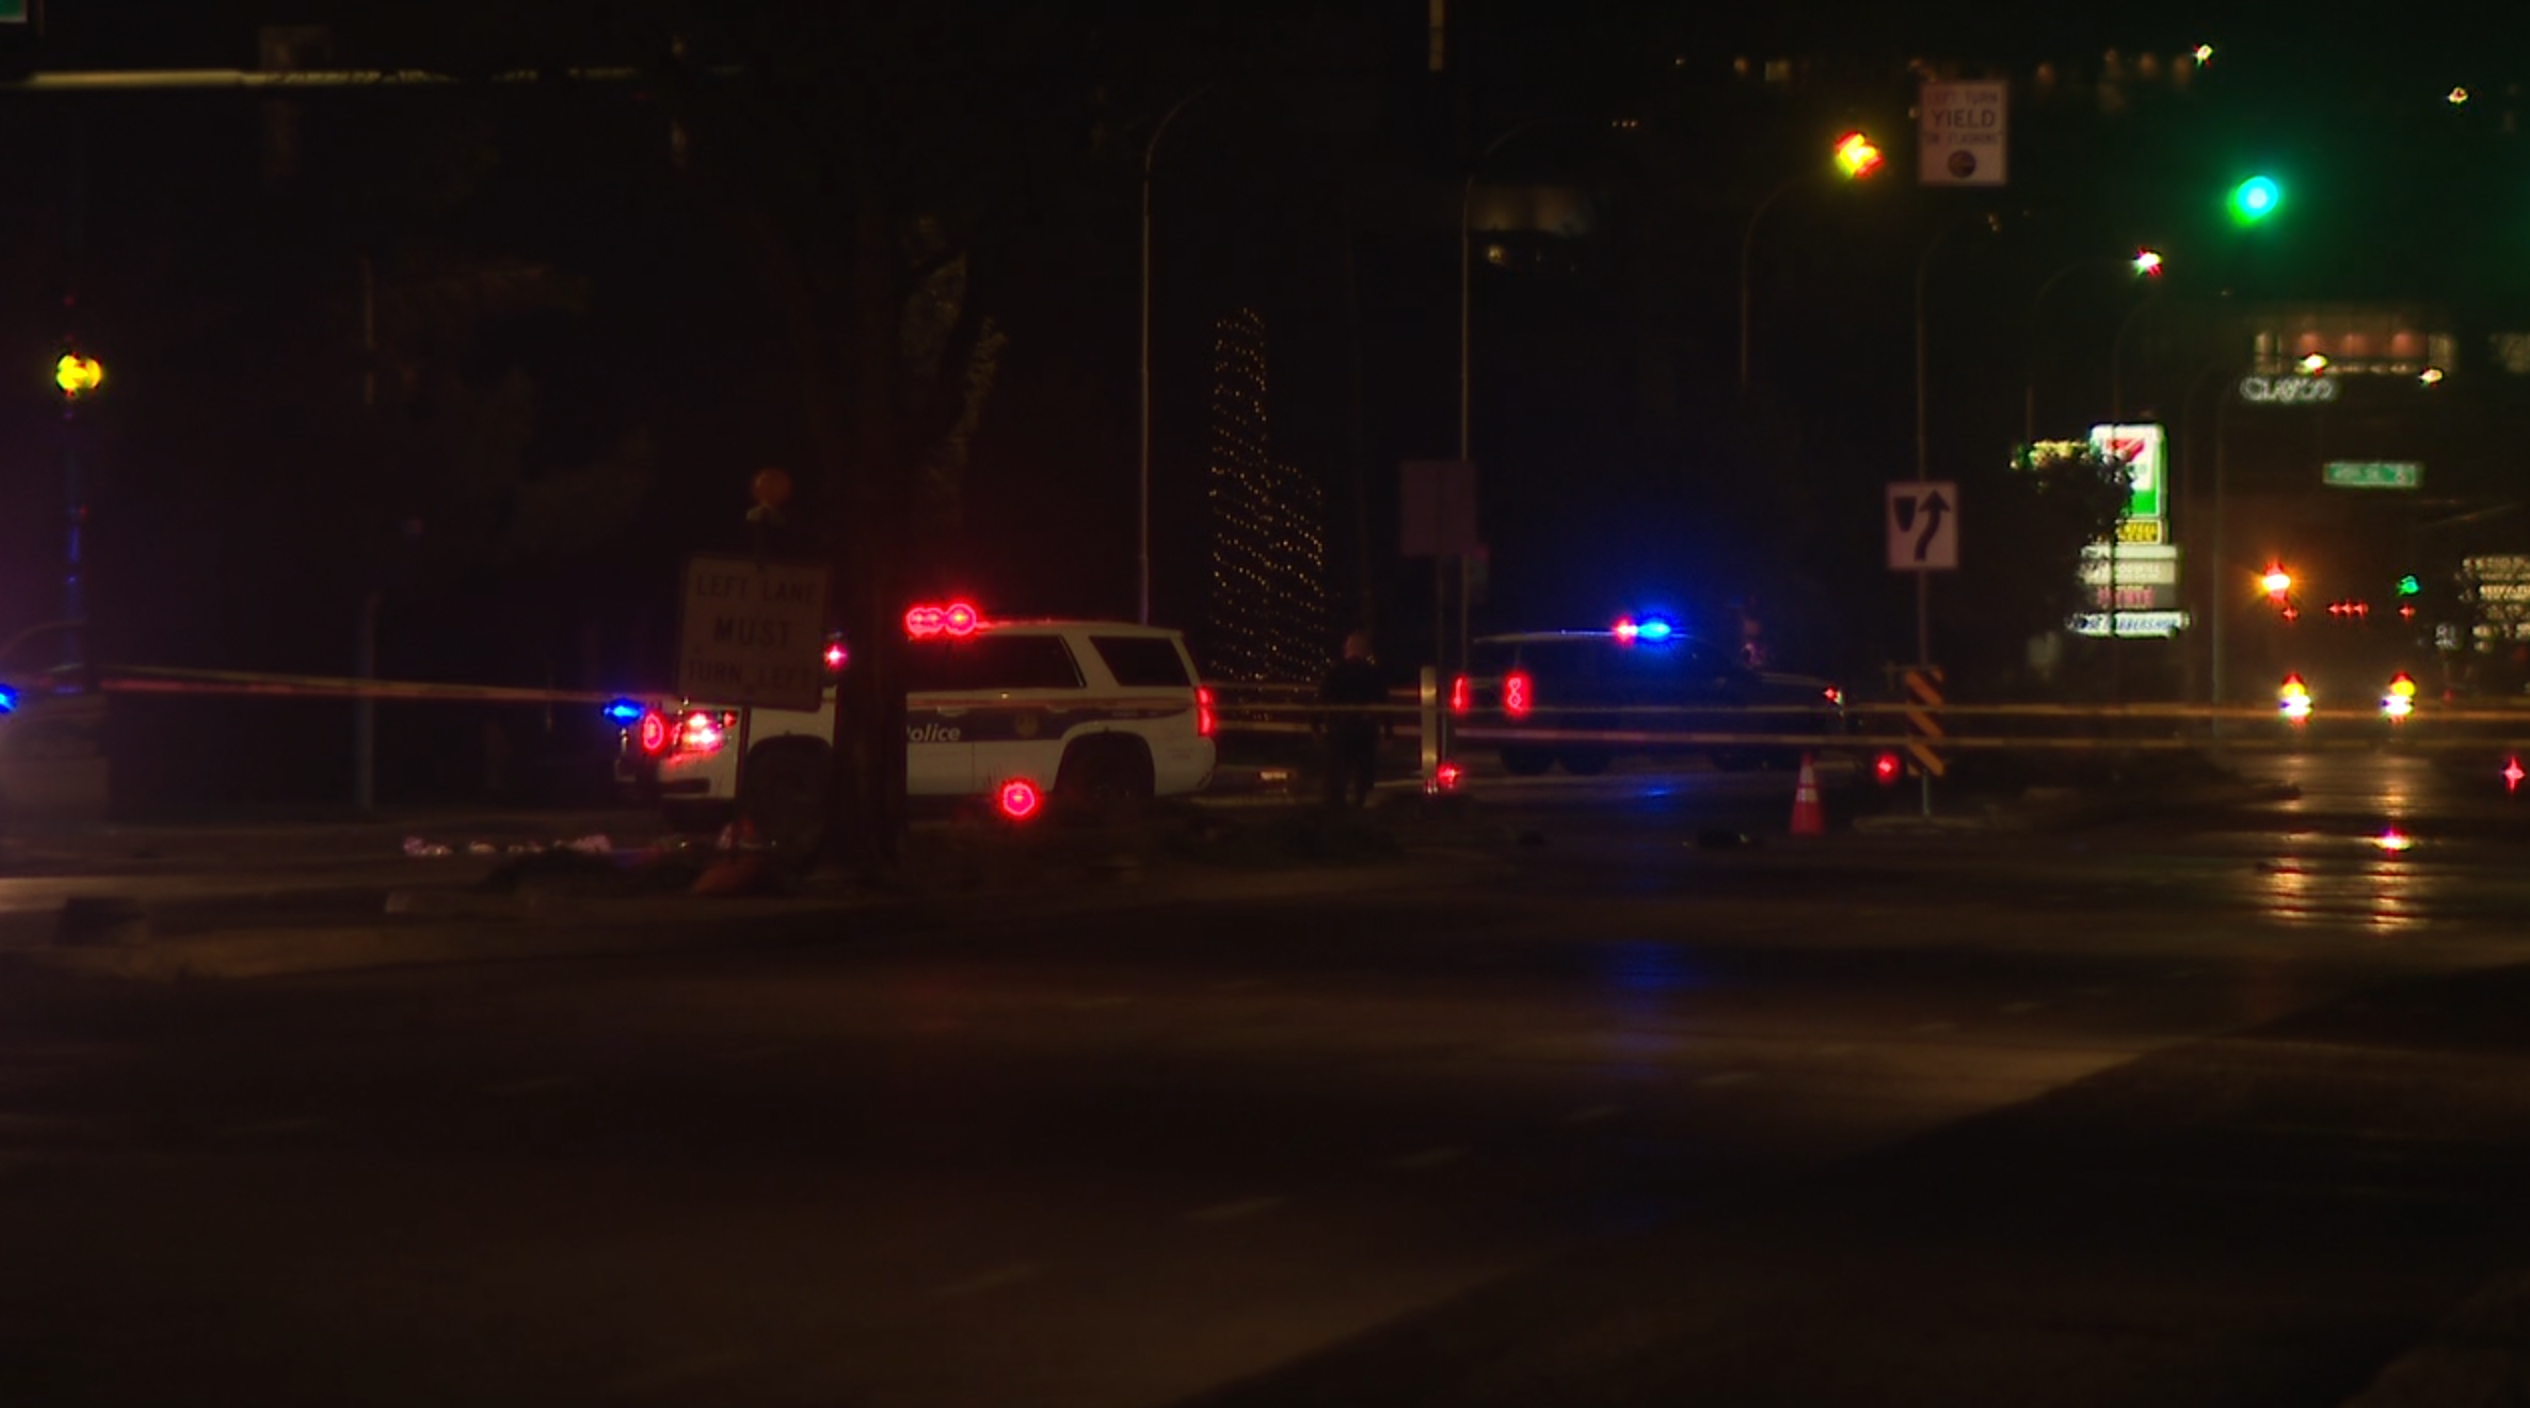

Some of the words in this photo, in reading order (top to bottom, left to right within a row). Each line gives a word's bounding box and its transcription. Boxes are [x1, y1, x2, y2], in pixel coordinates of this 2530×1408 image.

[1930, 109, 1996, 128] YIELD
[696, 574, 750, 597] LEFT
[763, 579, 817, 604] LANE
[714, 616, 791, 648] MUST
[689, 659, 742, 684] TURN
[758, 665, 811, 690] LEFT
